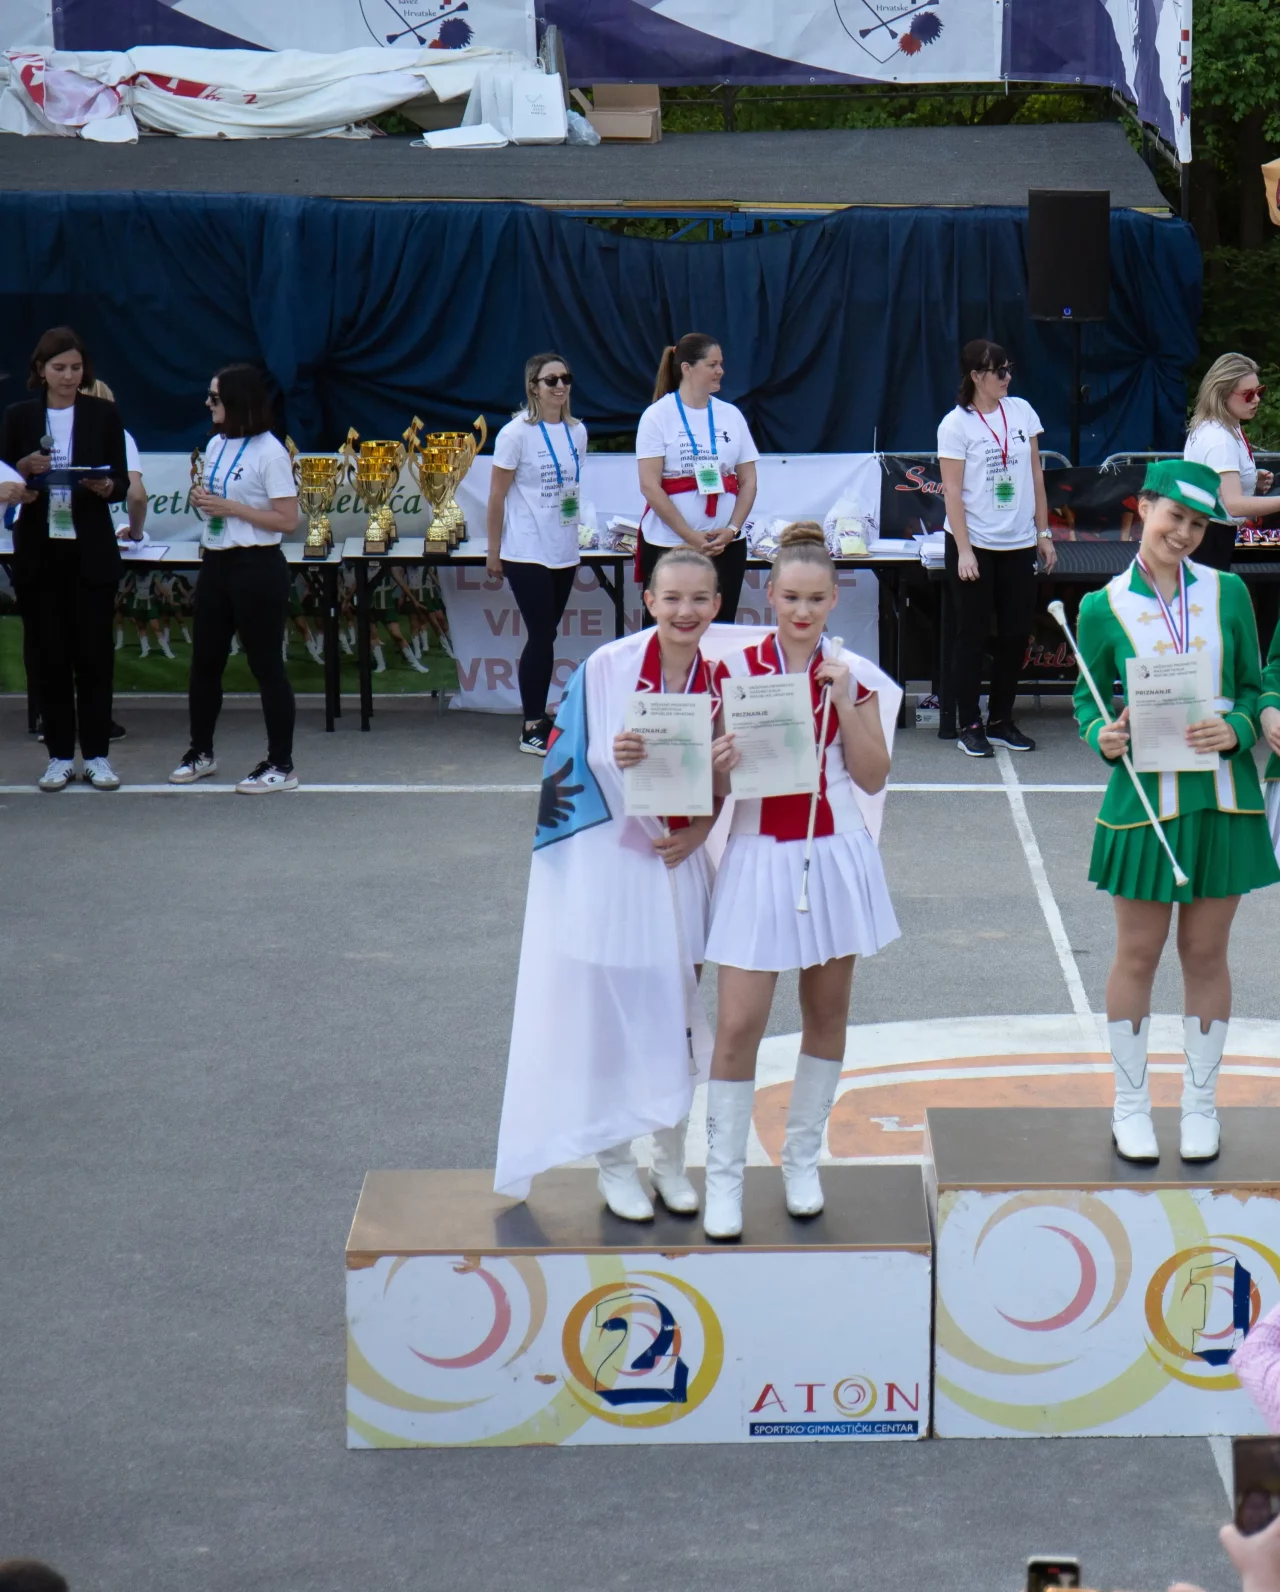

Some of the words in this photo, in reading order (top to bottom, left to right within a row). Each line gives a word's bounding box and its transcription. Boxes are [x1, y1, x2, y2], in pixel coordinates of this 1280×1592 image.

[403, 9, 437, 17] Hrvatske
[732, 710, 768, 718] PRIZNANJE
[594, 1293, 689, 1406] 2
[749, 1377, 919, 1417] ATON
[754, 1424, 804, 1435] SPORTSKO
[807, 1422, 872, 1434] GIMNASTIČKI
[873, 1423, 914, 1433] CENTAR
